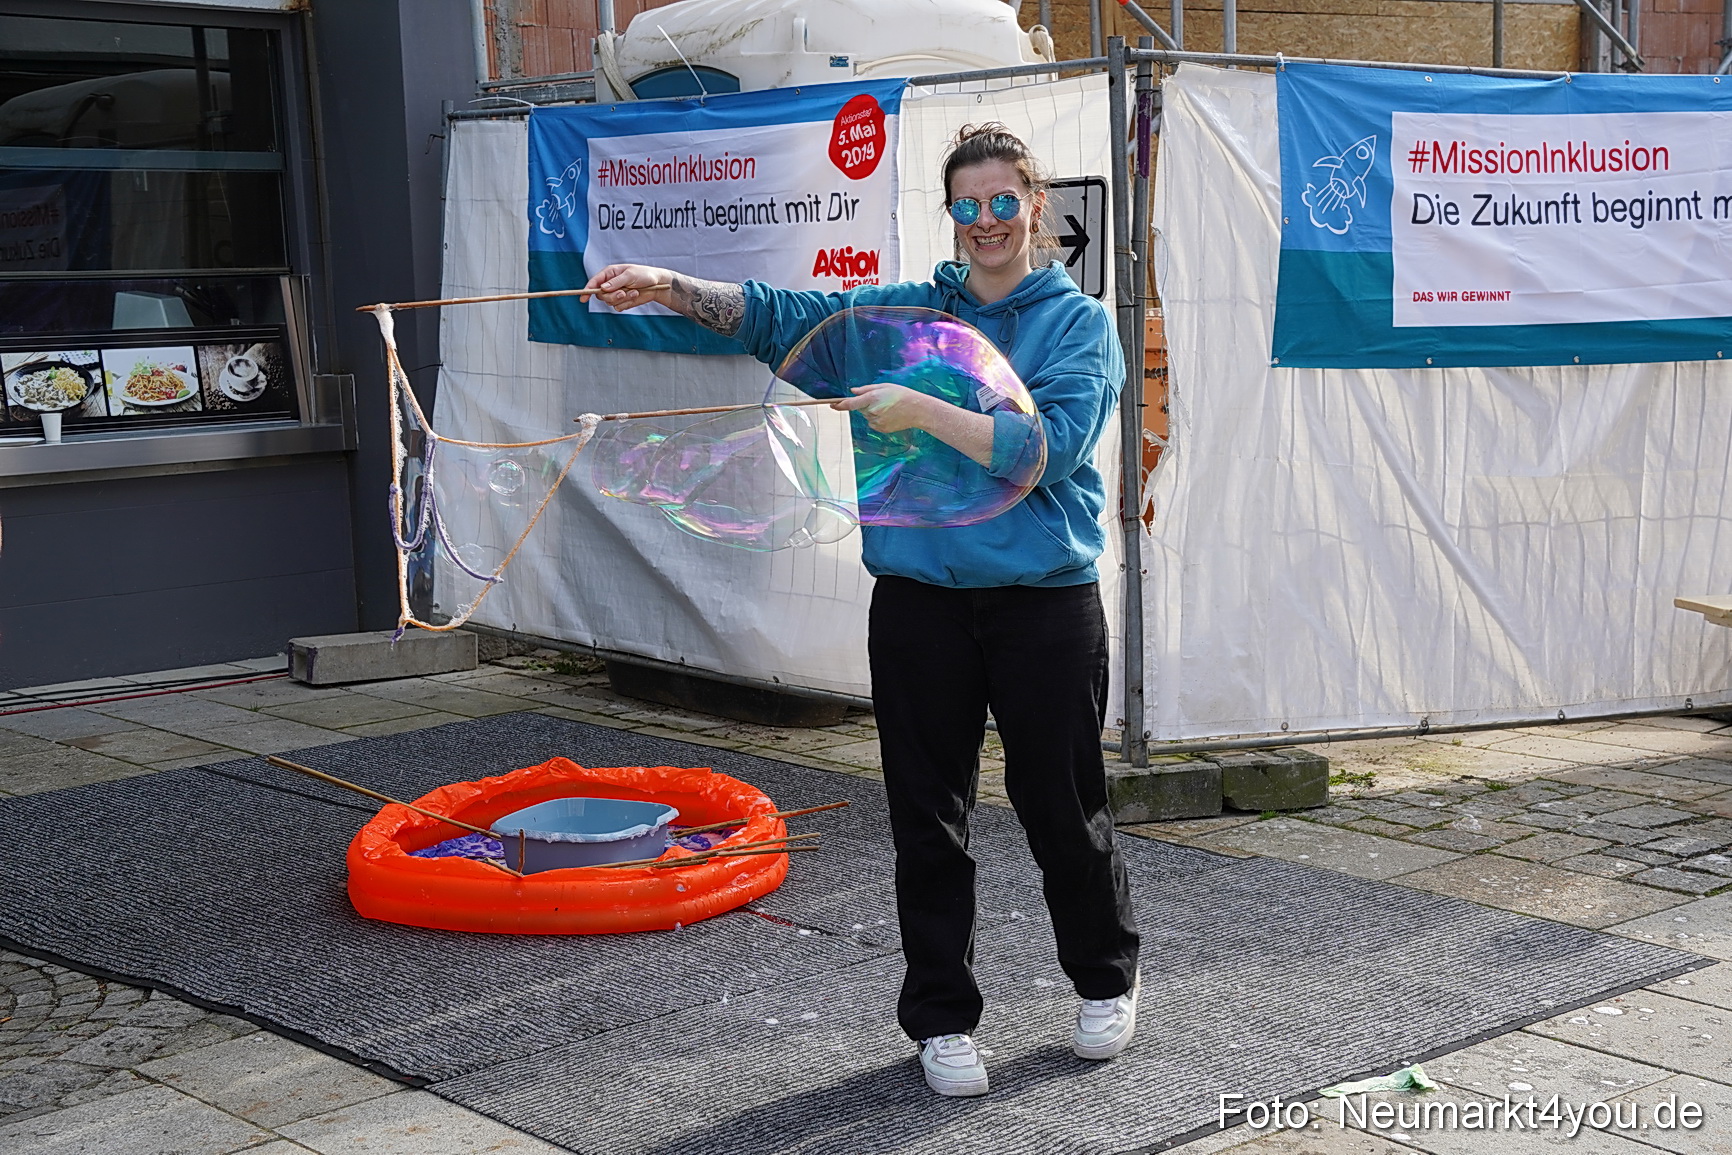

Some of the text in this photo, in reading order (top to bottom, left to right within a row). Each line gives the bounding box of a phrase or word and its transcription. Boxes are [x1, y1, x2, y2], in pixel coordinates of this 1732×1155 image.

[837, 119, 877, 146] 5. Mai
[840, 108, 872, 127] Aktionstag
[598, 152, 755, 188] #MissionInklusion
[841, 141, 876, 169] 2019
[1407, 140, 1669, 174] #MissionInklusion
[598, 191, 861, 232] Die Zukunft beginnt mit Dir
[1411, 193, 1461, 226] Die
[1471, 193, 1582, 226] Zukunft
[1592, 190, 1703, 229] beginnt
[1412, 290, 1511, 302] DAS WIR GEWINNT
